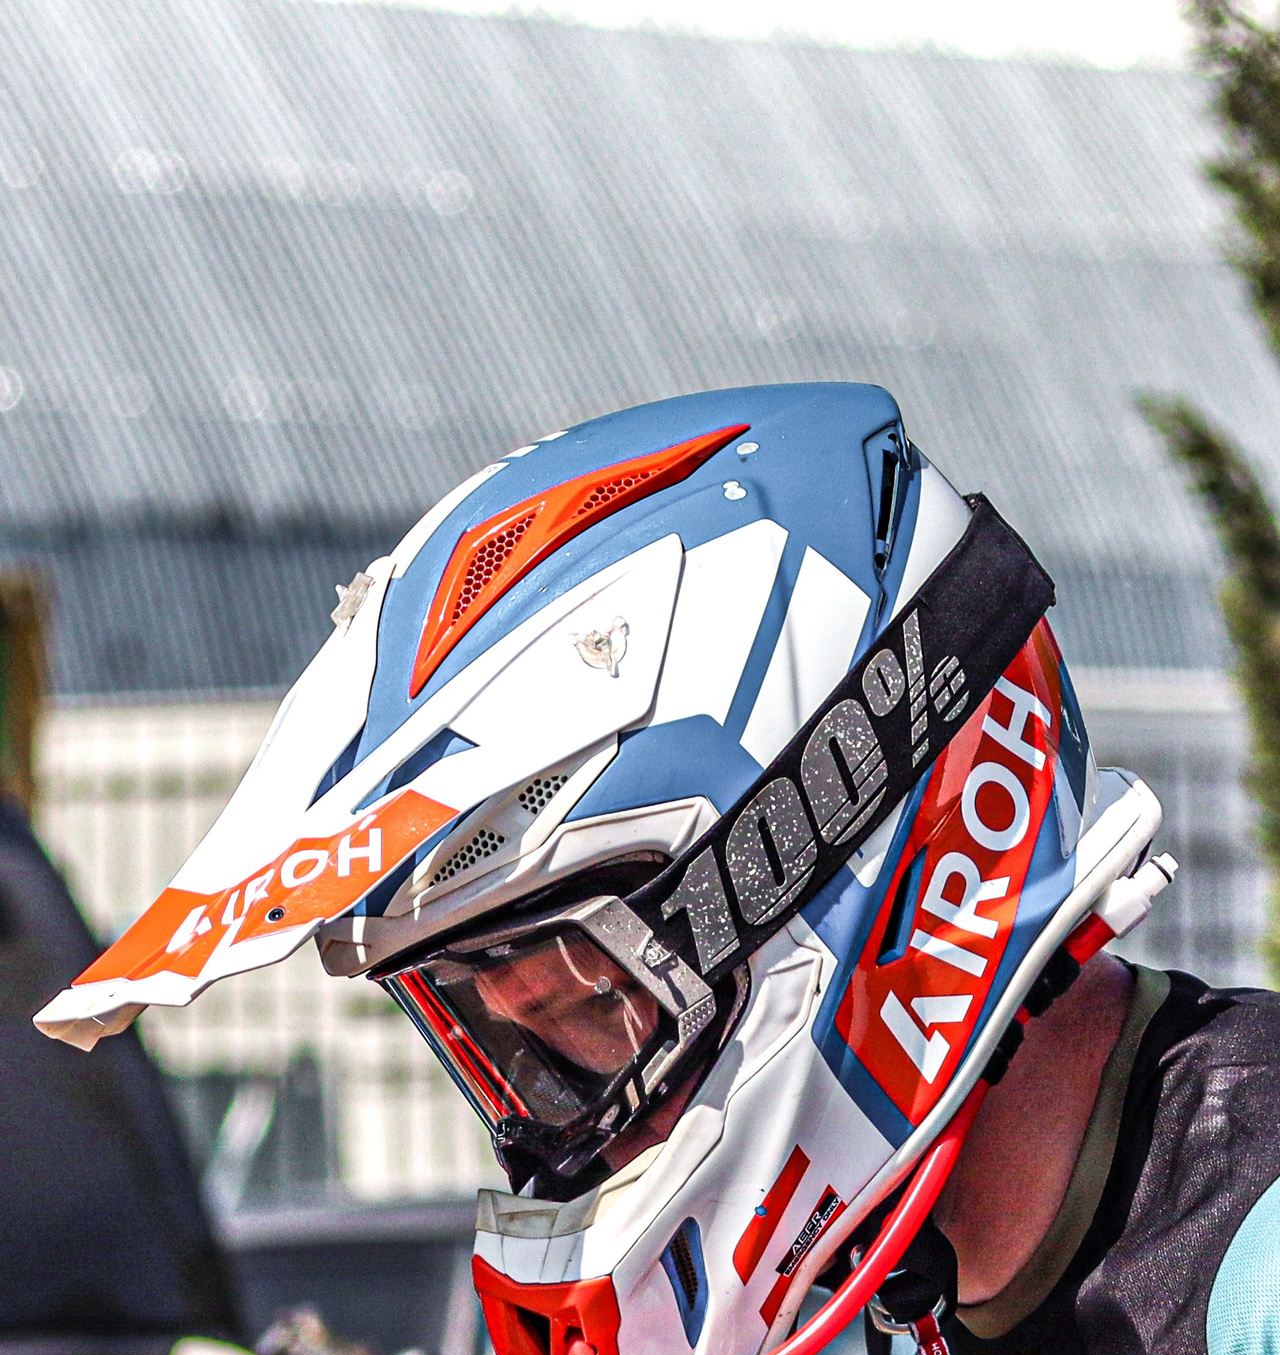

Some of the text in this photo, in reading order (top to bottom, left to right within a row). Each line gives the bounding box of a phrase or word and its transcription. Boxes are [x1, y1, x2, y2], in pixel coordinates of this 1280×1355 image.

[661, 608, 970, 975] 100%
[880, 677, 1054, 1084] AIROH
[784, 1196, 840, 1276] EMERGENCY ONLY
